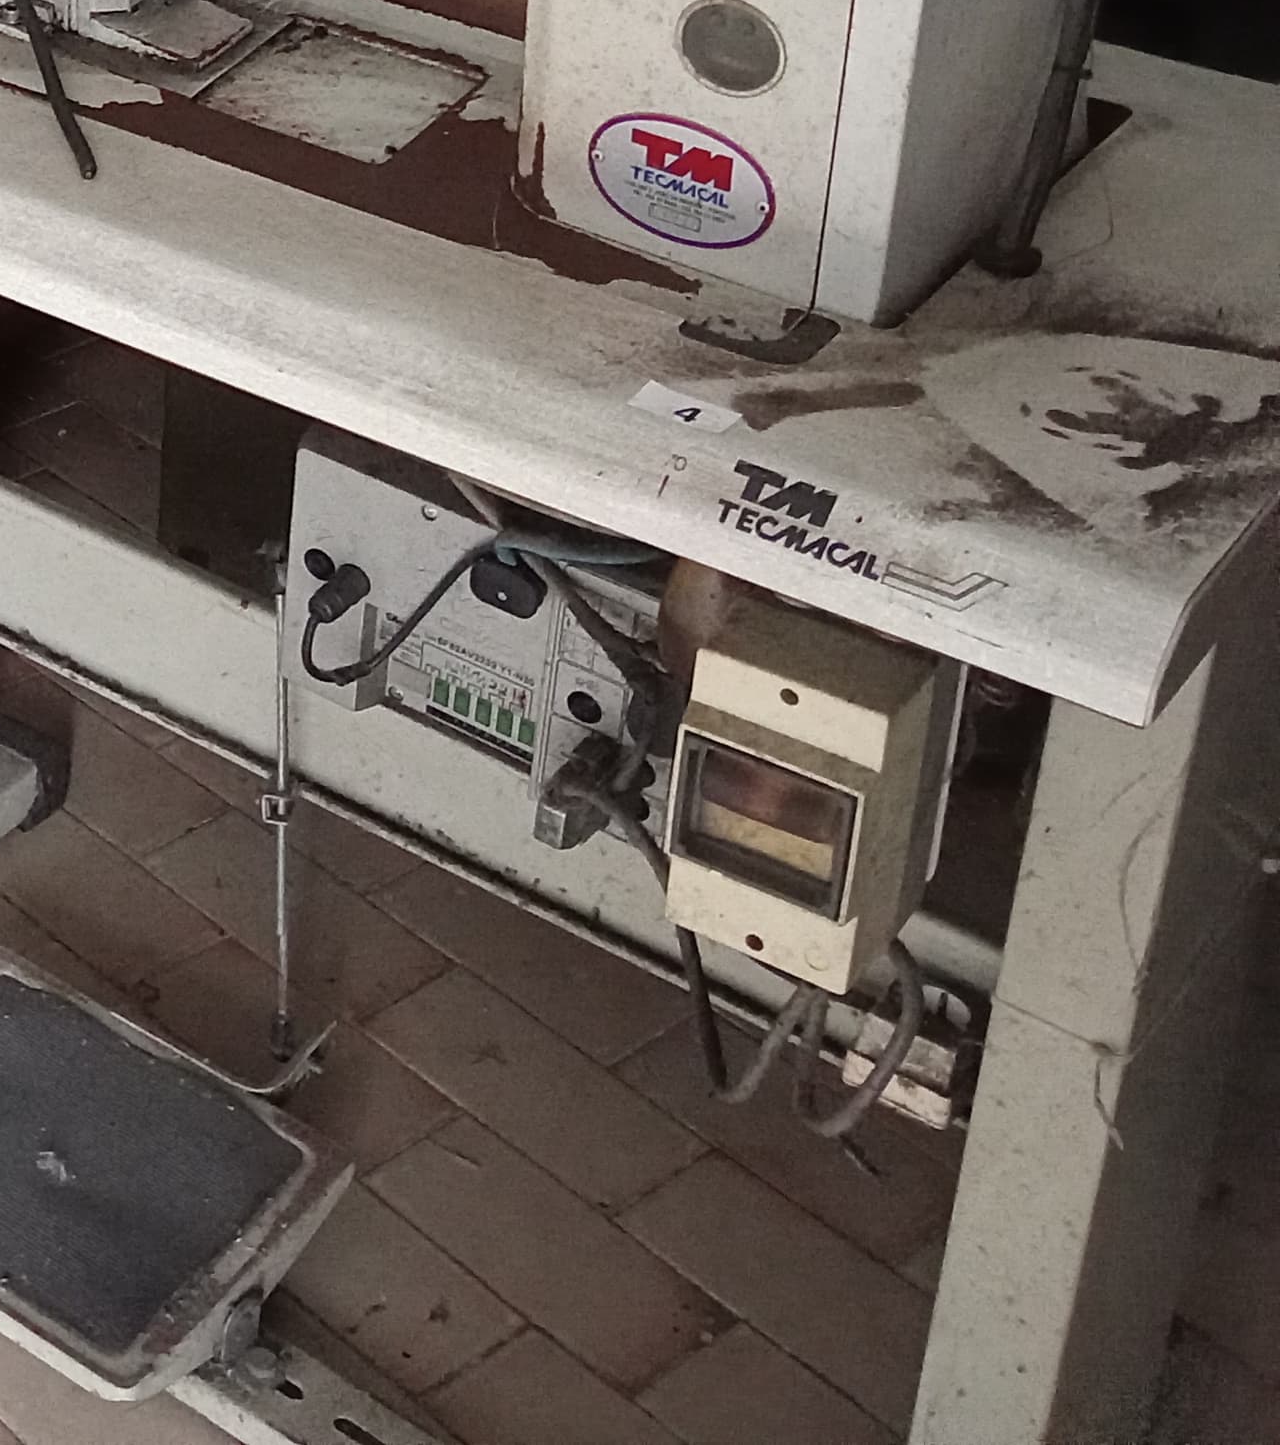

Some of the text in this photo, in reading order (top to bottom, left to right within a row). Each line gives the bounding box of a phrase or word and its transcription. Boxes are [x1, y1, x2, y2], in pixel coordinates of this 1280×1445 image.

[629, 165, 729, 209] TECMACAL
[631, 128, 734, 192] TM
[674, 408, 701, 422] 4
[734, 459, 838, 528] TM
[717, 498, 880, 582] TECMACAL
